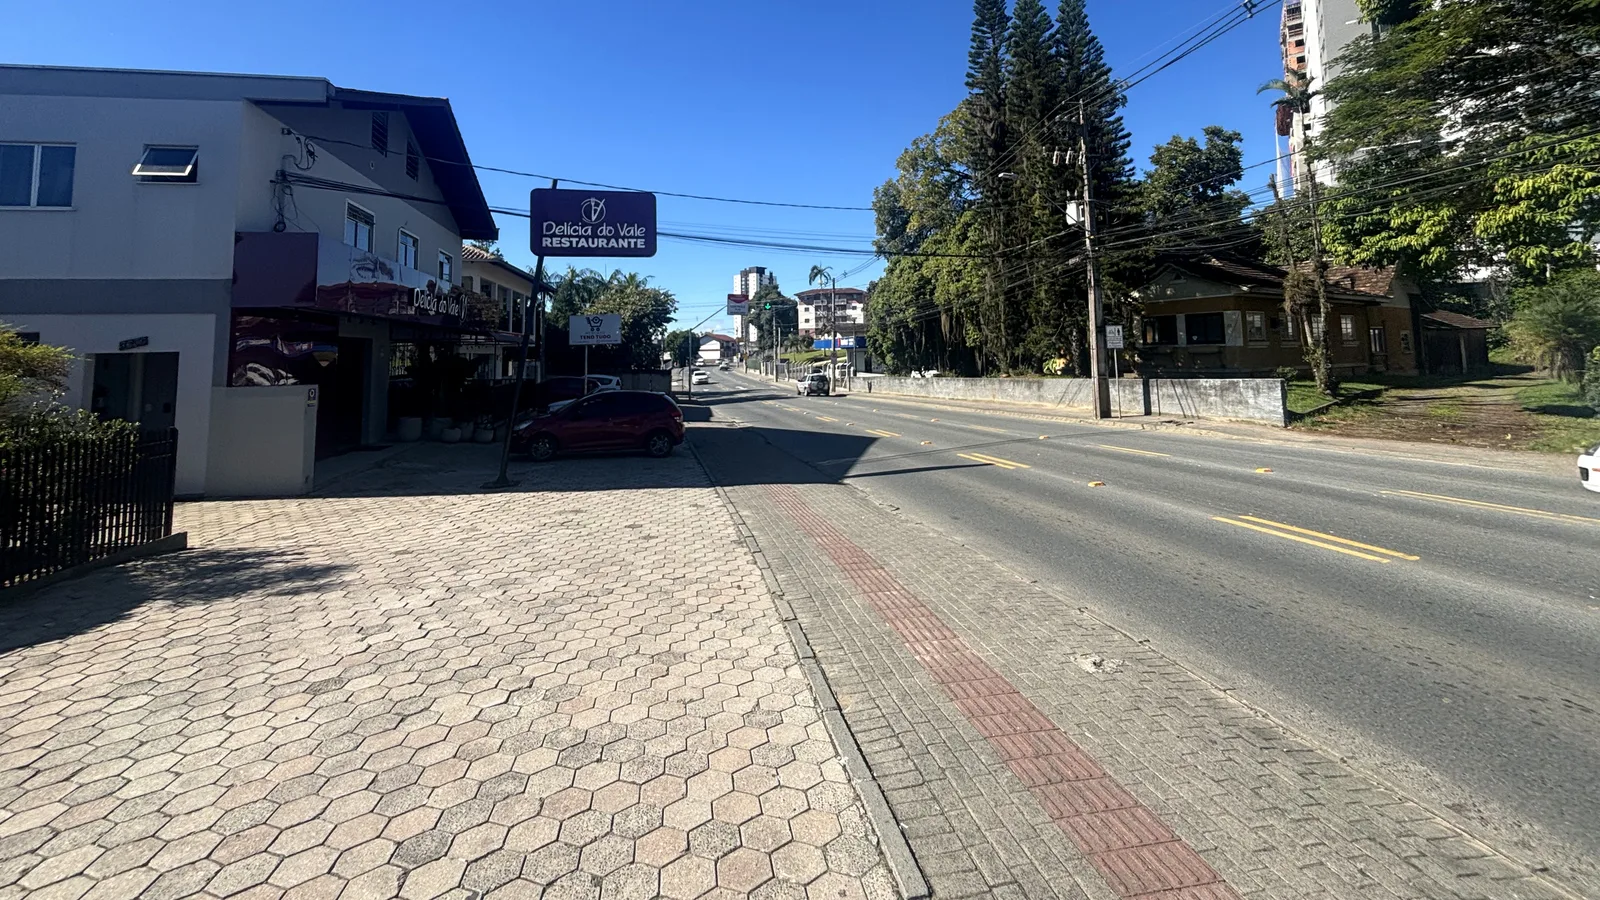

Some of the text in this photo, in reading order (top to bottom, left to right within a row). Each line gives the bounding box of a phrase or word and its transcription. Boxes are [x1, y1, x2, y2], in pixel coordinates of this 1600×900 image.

[542, 221, 646, 237] Delícia do Vale
[542, 237, 646, 248] RESTAURANTE
[438, 294, 447, 313] do
